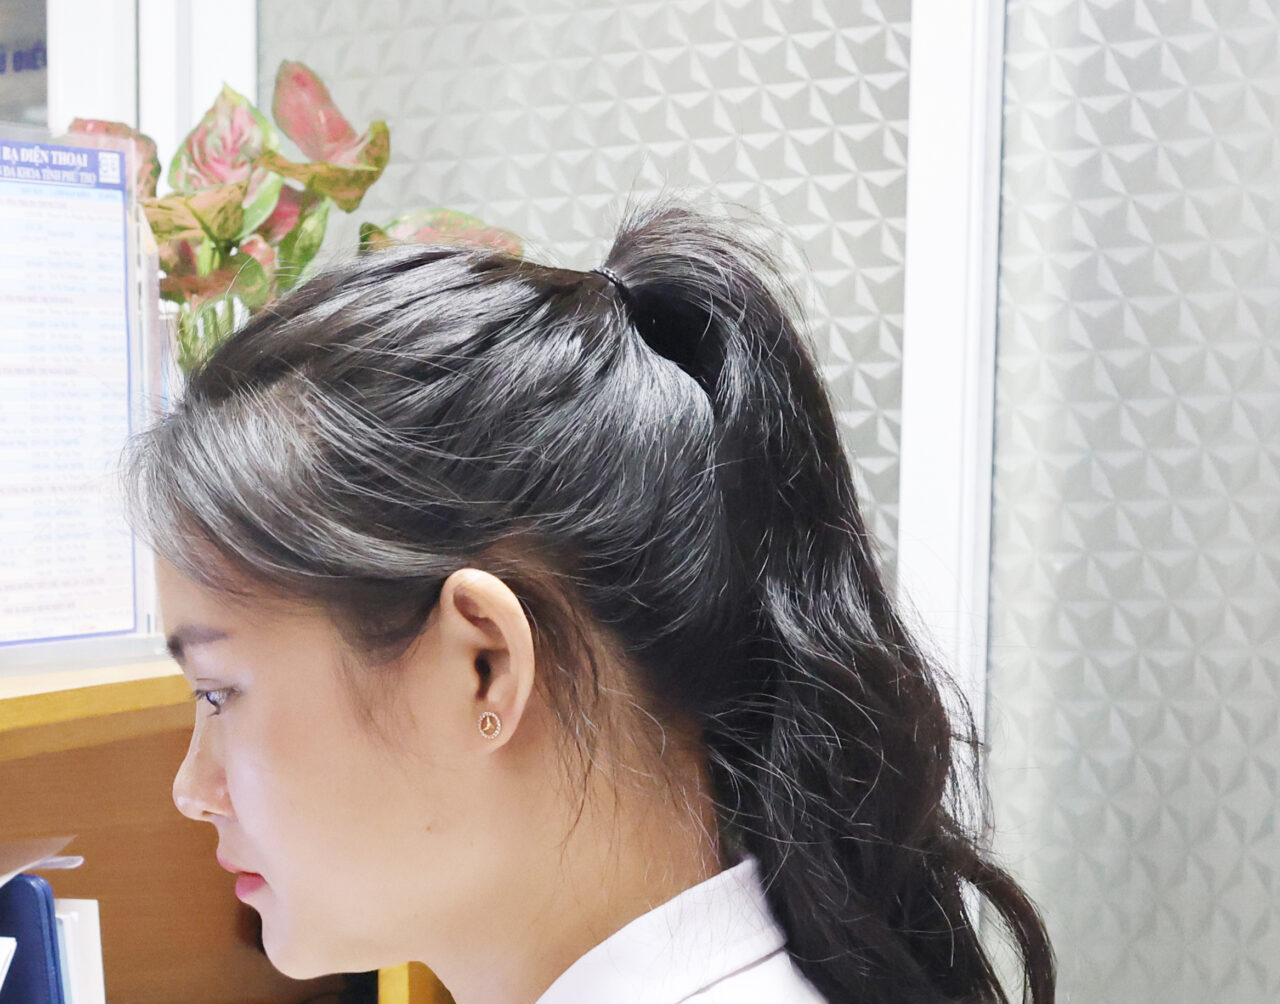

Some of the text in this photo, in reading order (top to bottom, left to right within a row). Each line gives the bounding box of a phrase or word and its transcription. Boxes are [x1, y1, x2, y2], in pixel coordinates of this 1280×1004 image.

[3, 146, 19, 165] BẠ
[21, 145, 49, 166] ĐIỆN
[51, 151, 88, 168] THOẠI
[17, 166, 41, 180] KHOA
